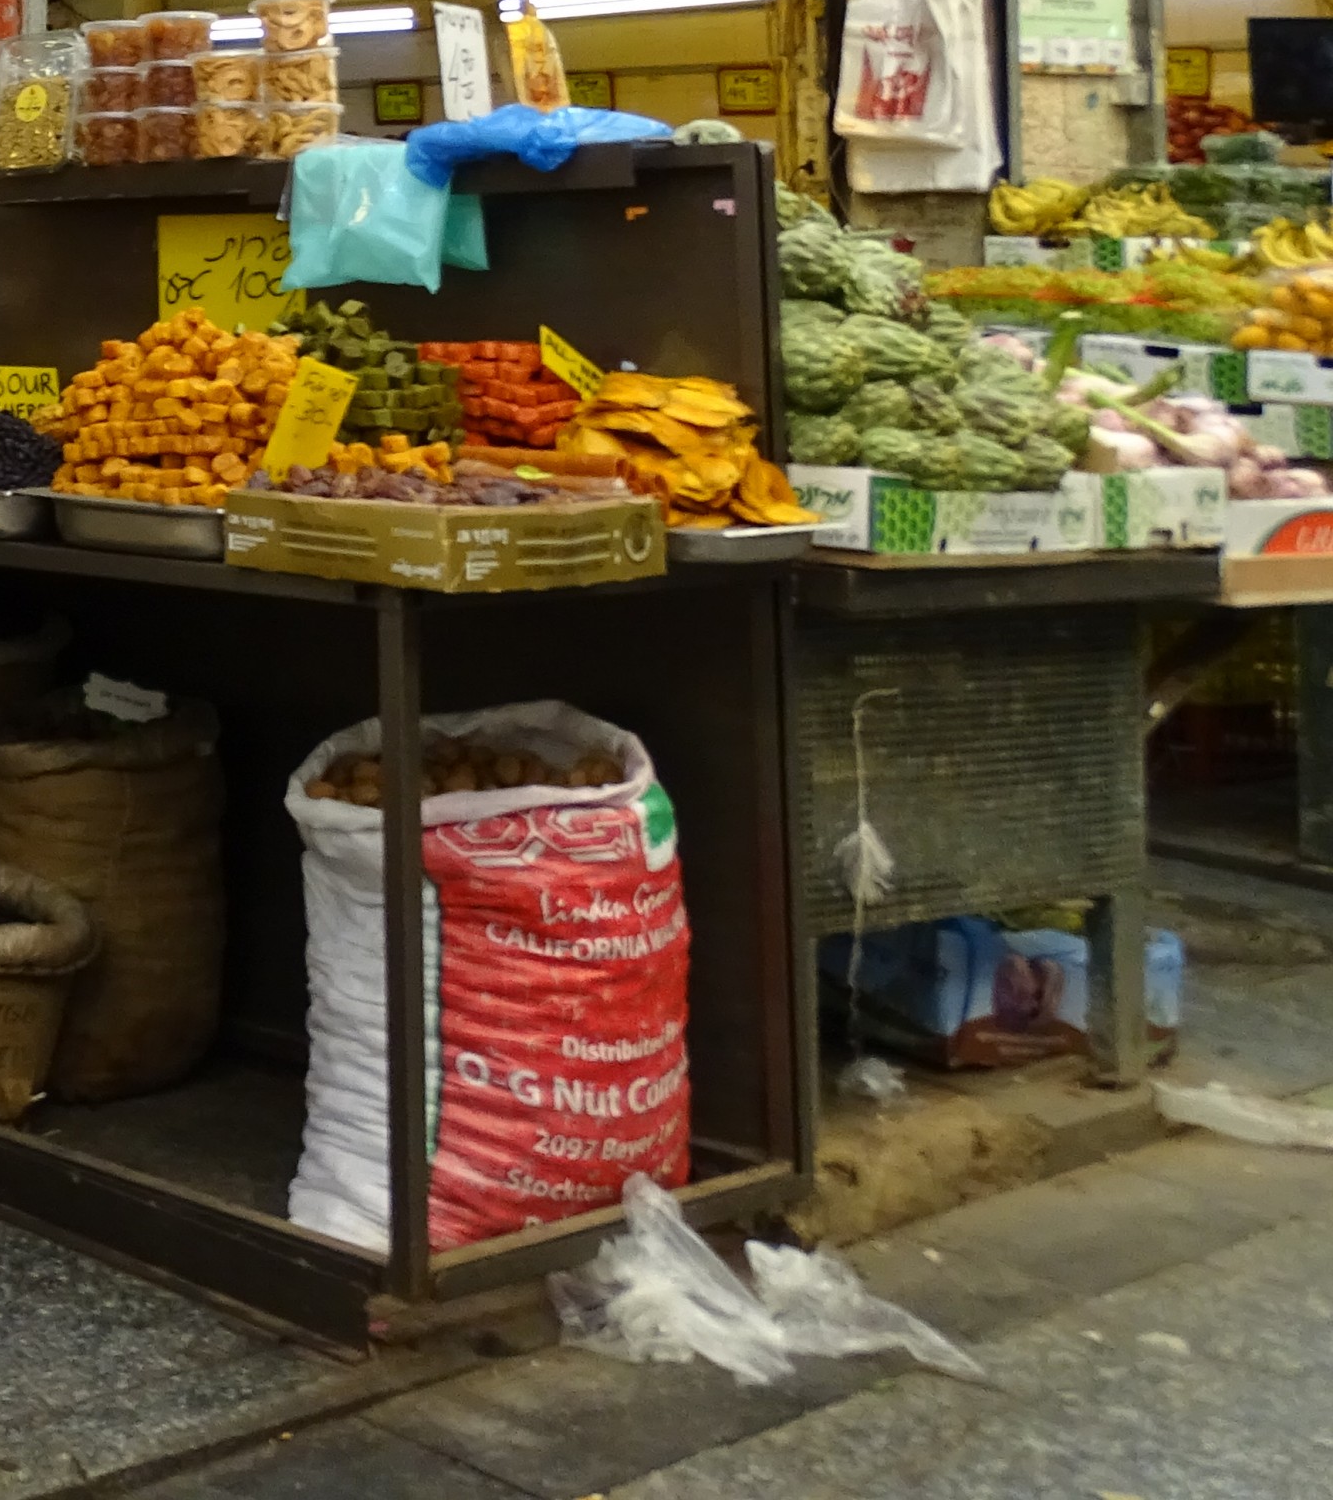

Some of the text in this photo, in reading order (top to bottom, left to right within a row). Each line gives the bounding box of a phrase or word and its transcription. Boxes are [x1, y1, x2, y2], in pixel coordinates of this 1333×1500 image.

[539, 886, 630, 926] Linden
[484, 922, 649, 962] CALIFORNIA
[552, 1075, 622, 1118] Nut
